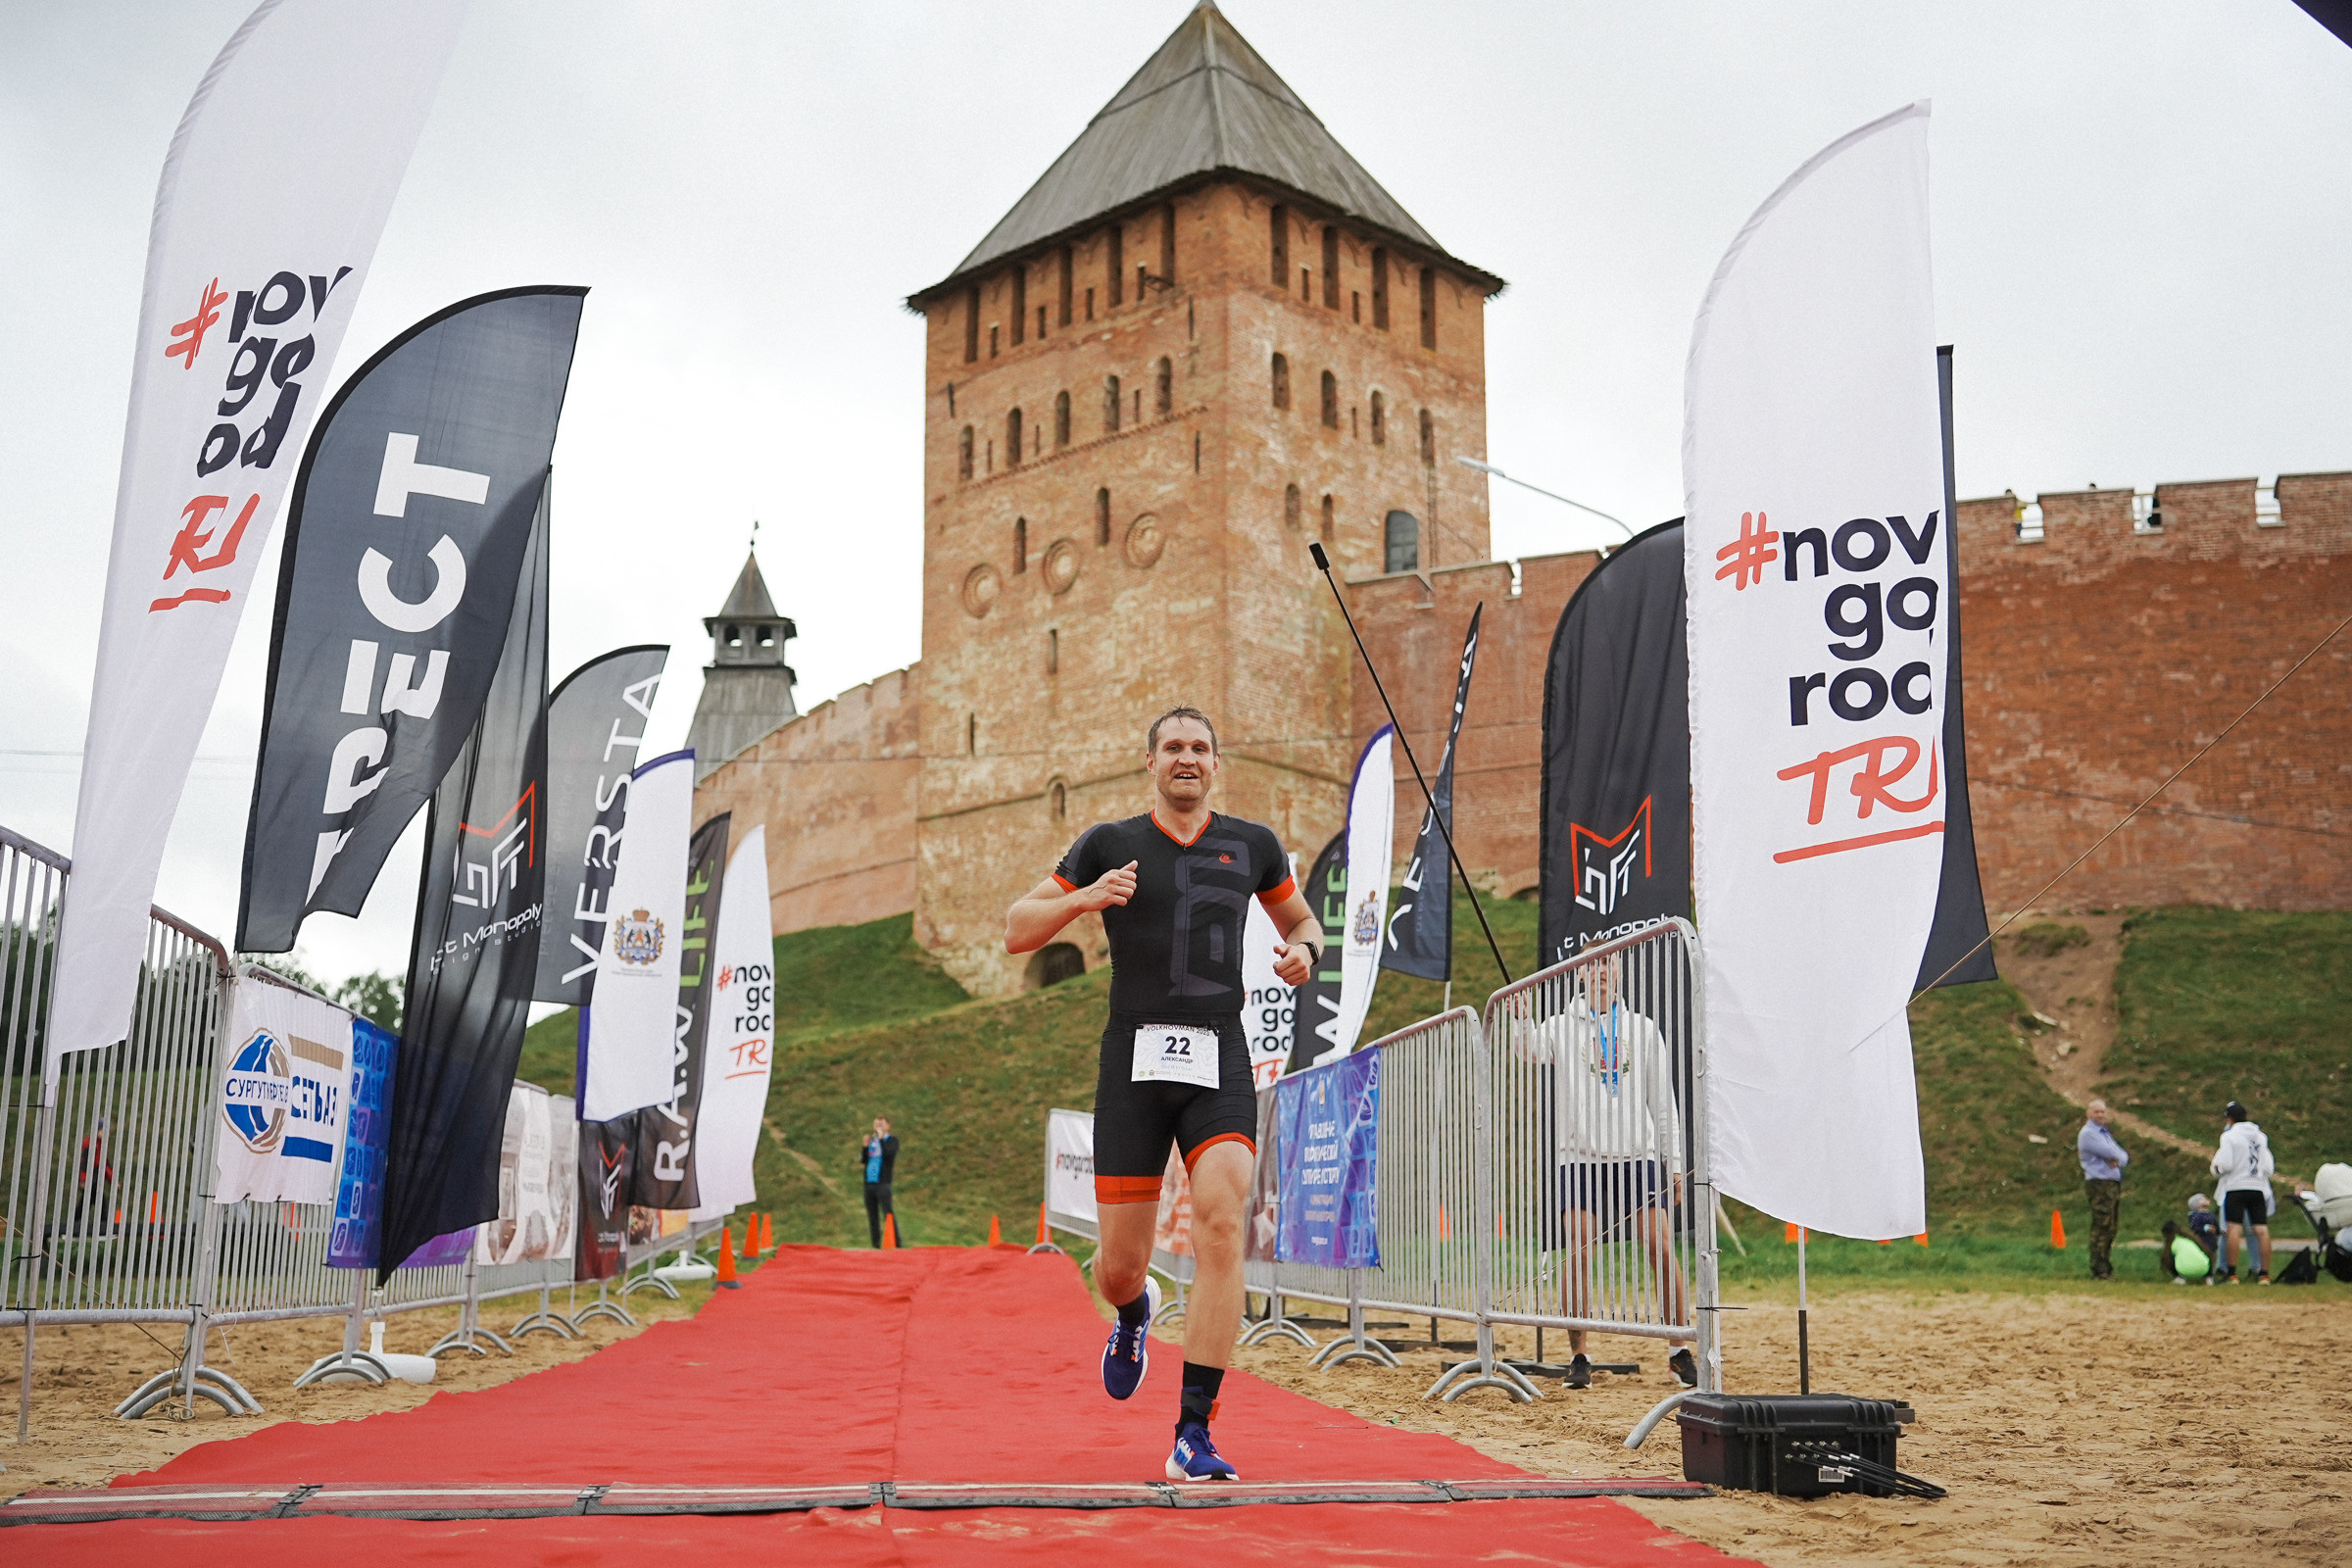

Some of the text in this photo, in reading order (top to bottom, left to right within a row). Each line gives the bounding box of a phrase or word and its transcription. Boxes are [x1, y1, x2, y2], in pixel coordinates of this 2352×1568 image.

[217, 332, 316, 417] go
[1715, 509, 1940, 592] #nov
[1824, 576, 1939, 662] go
[305, 431, 491, 907] PECT
[561, 672, 663, 985] VERSTA
[463, 903, 543, 949] Monopoly
[1579, 912, 1670, 948] Monopol
[1245, 987, 1296, 1006] nov
[1146, 1024, 1195, 1033] VOLKHOVMAN
[1261, 1007, 1295, 1032] go
[1160, 1055, 1194, 1064] АЛЕКСАНДР
[1164, 1036, 1191, 1056] 22
